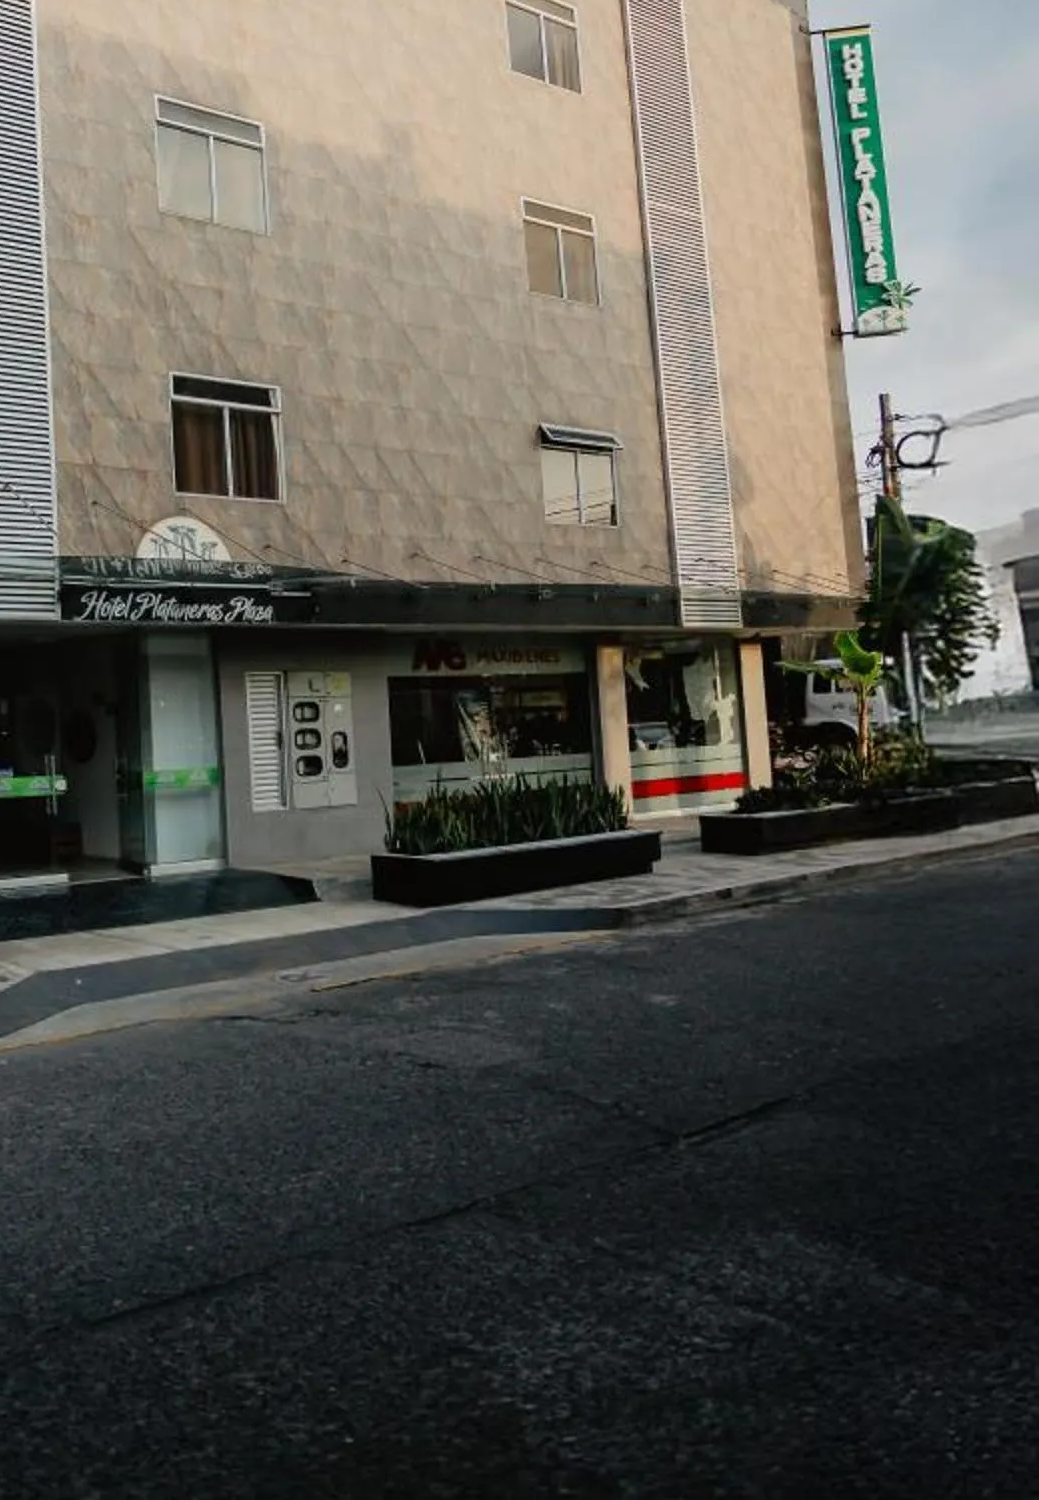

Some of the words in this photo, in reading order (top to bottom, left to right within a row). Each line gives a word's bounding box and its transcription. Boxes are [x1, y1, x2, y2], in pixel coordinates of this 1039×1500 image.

[842, 43, 867, 120] HOTEL
[80, 590, 134, 622] Hotel
[225, 596, 273, 622] Plaza
